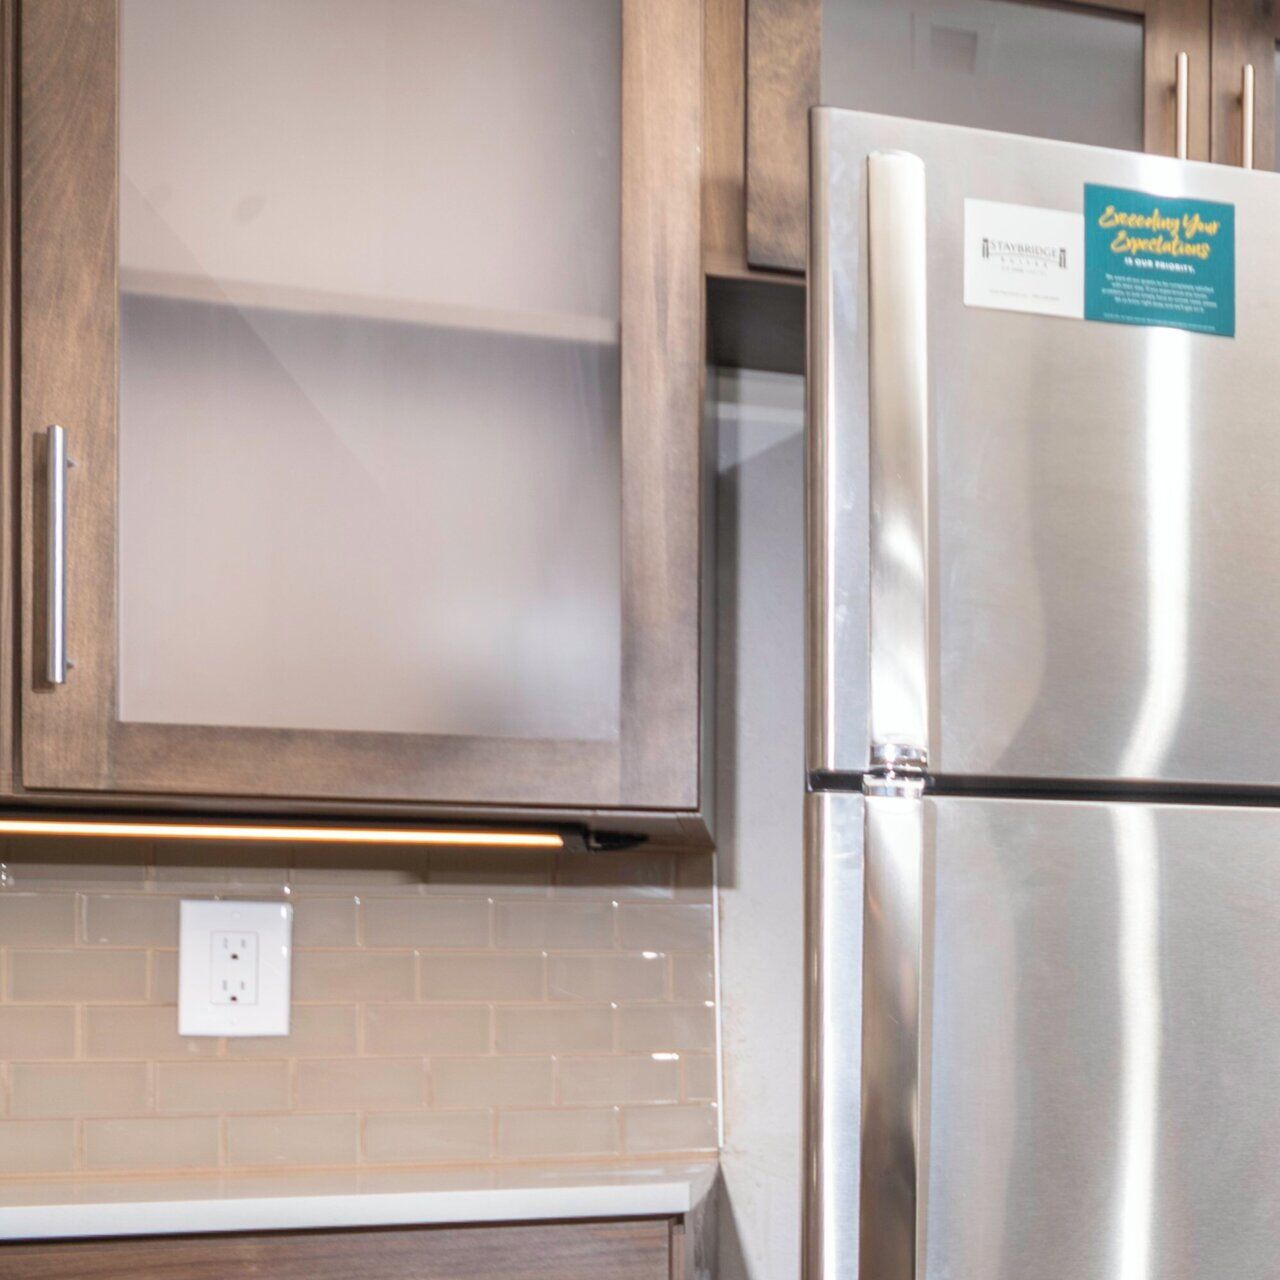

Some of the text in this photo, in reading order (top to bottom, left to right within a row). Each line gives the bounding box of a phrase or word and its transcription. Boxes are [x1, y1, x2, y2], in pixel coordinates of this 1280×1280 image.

[1099, 205, 1219, 241] Exceeding Your
[990, 240, 1055, 257] STAYBRIDGE
[1111, 230, 1210, 259] Expectations
[1124, 257, 1133, 266] IS
[1135, 258, 1153, 268] OUR
